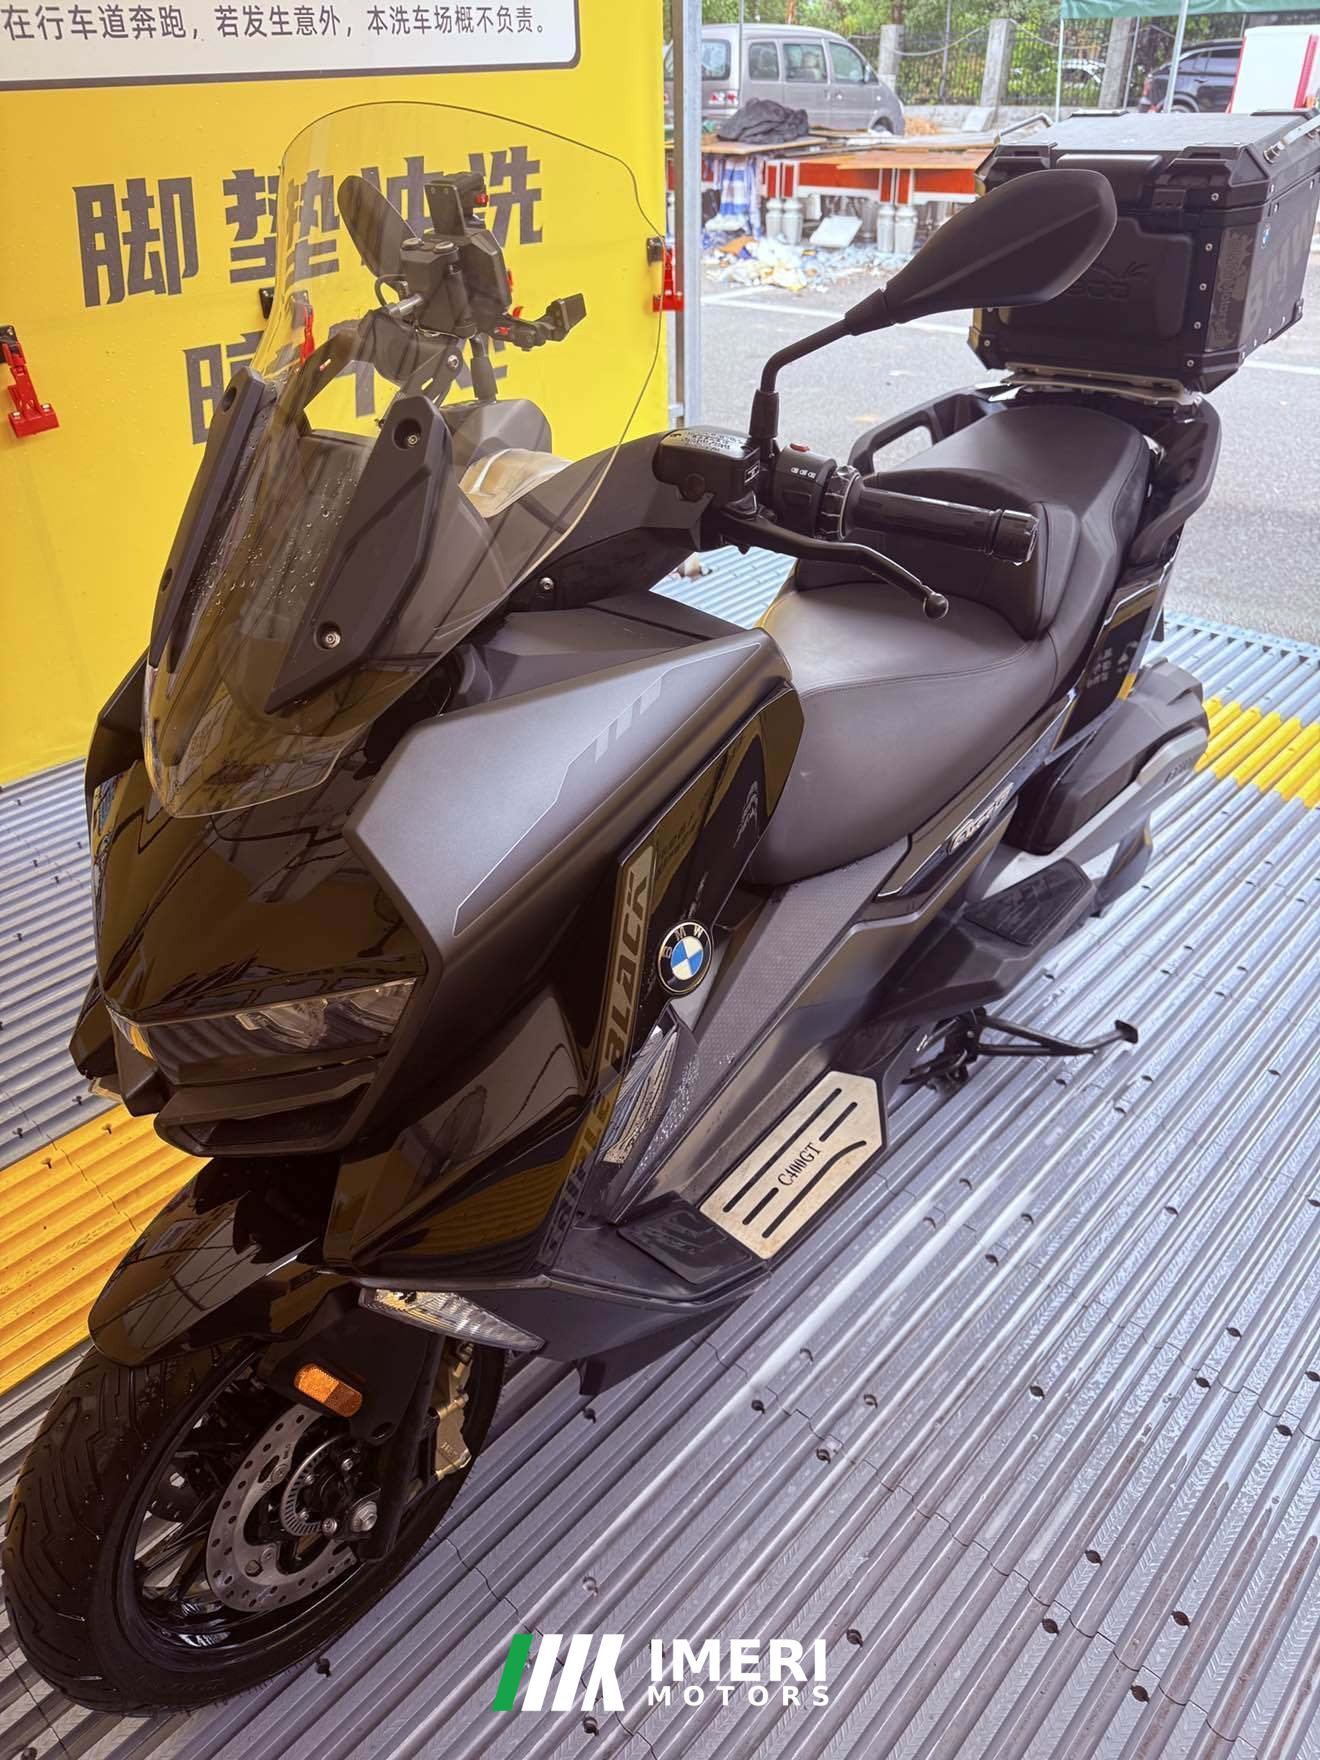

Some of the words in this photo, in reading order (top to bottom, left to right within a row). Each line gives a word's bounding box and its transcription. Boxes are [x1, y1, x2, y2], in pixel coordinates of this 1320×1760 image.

[662, 924, 705, 960] BMW
[605, 870, 648, 1071] BLACK
[777, 1141, 821, 1186] C400GT
